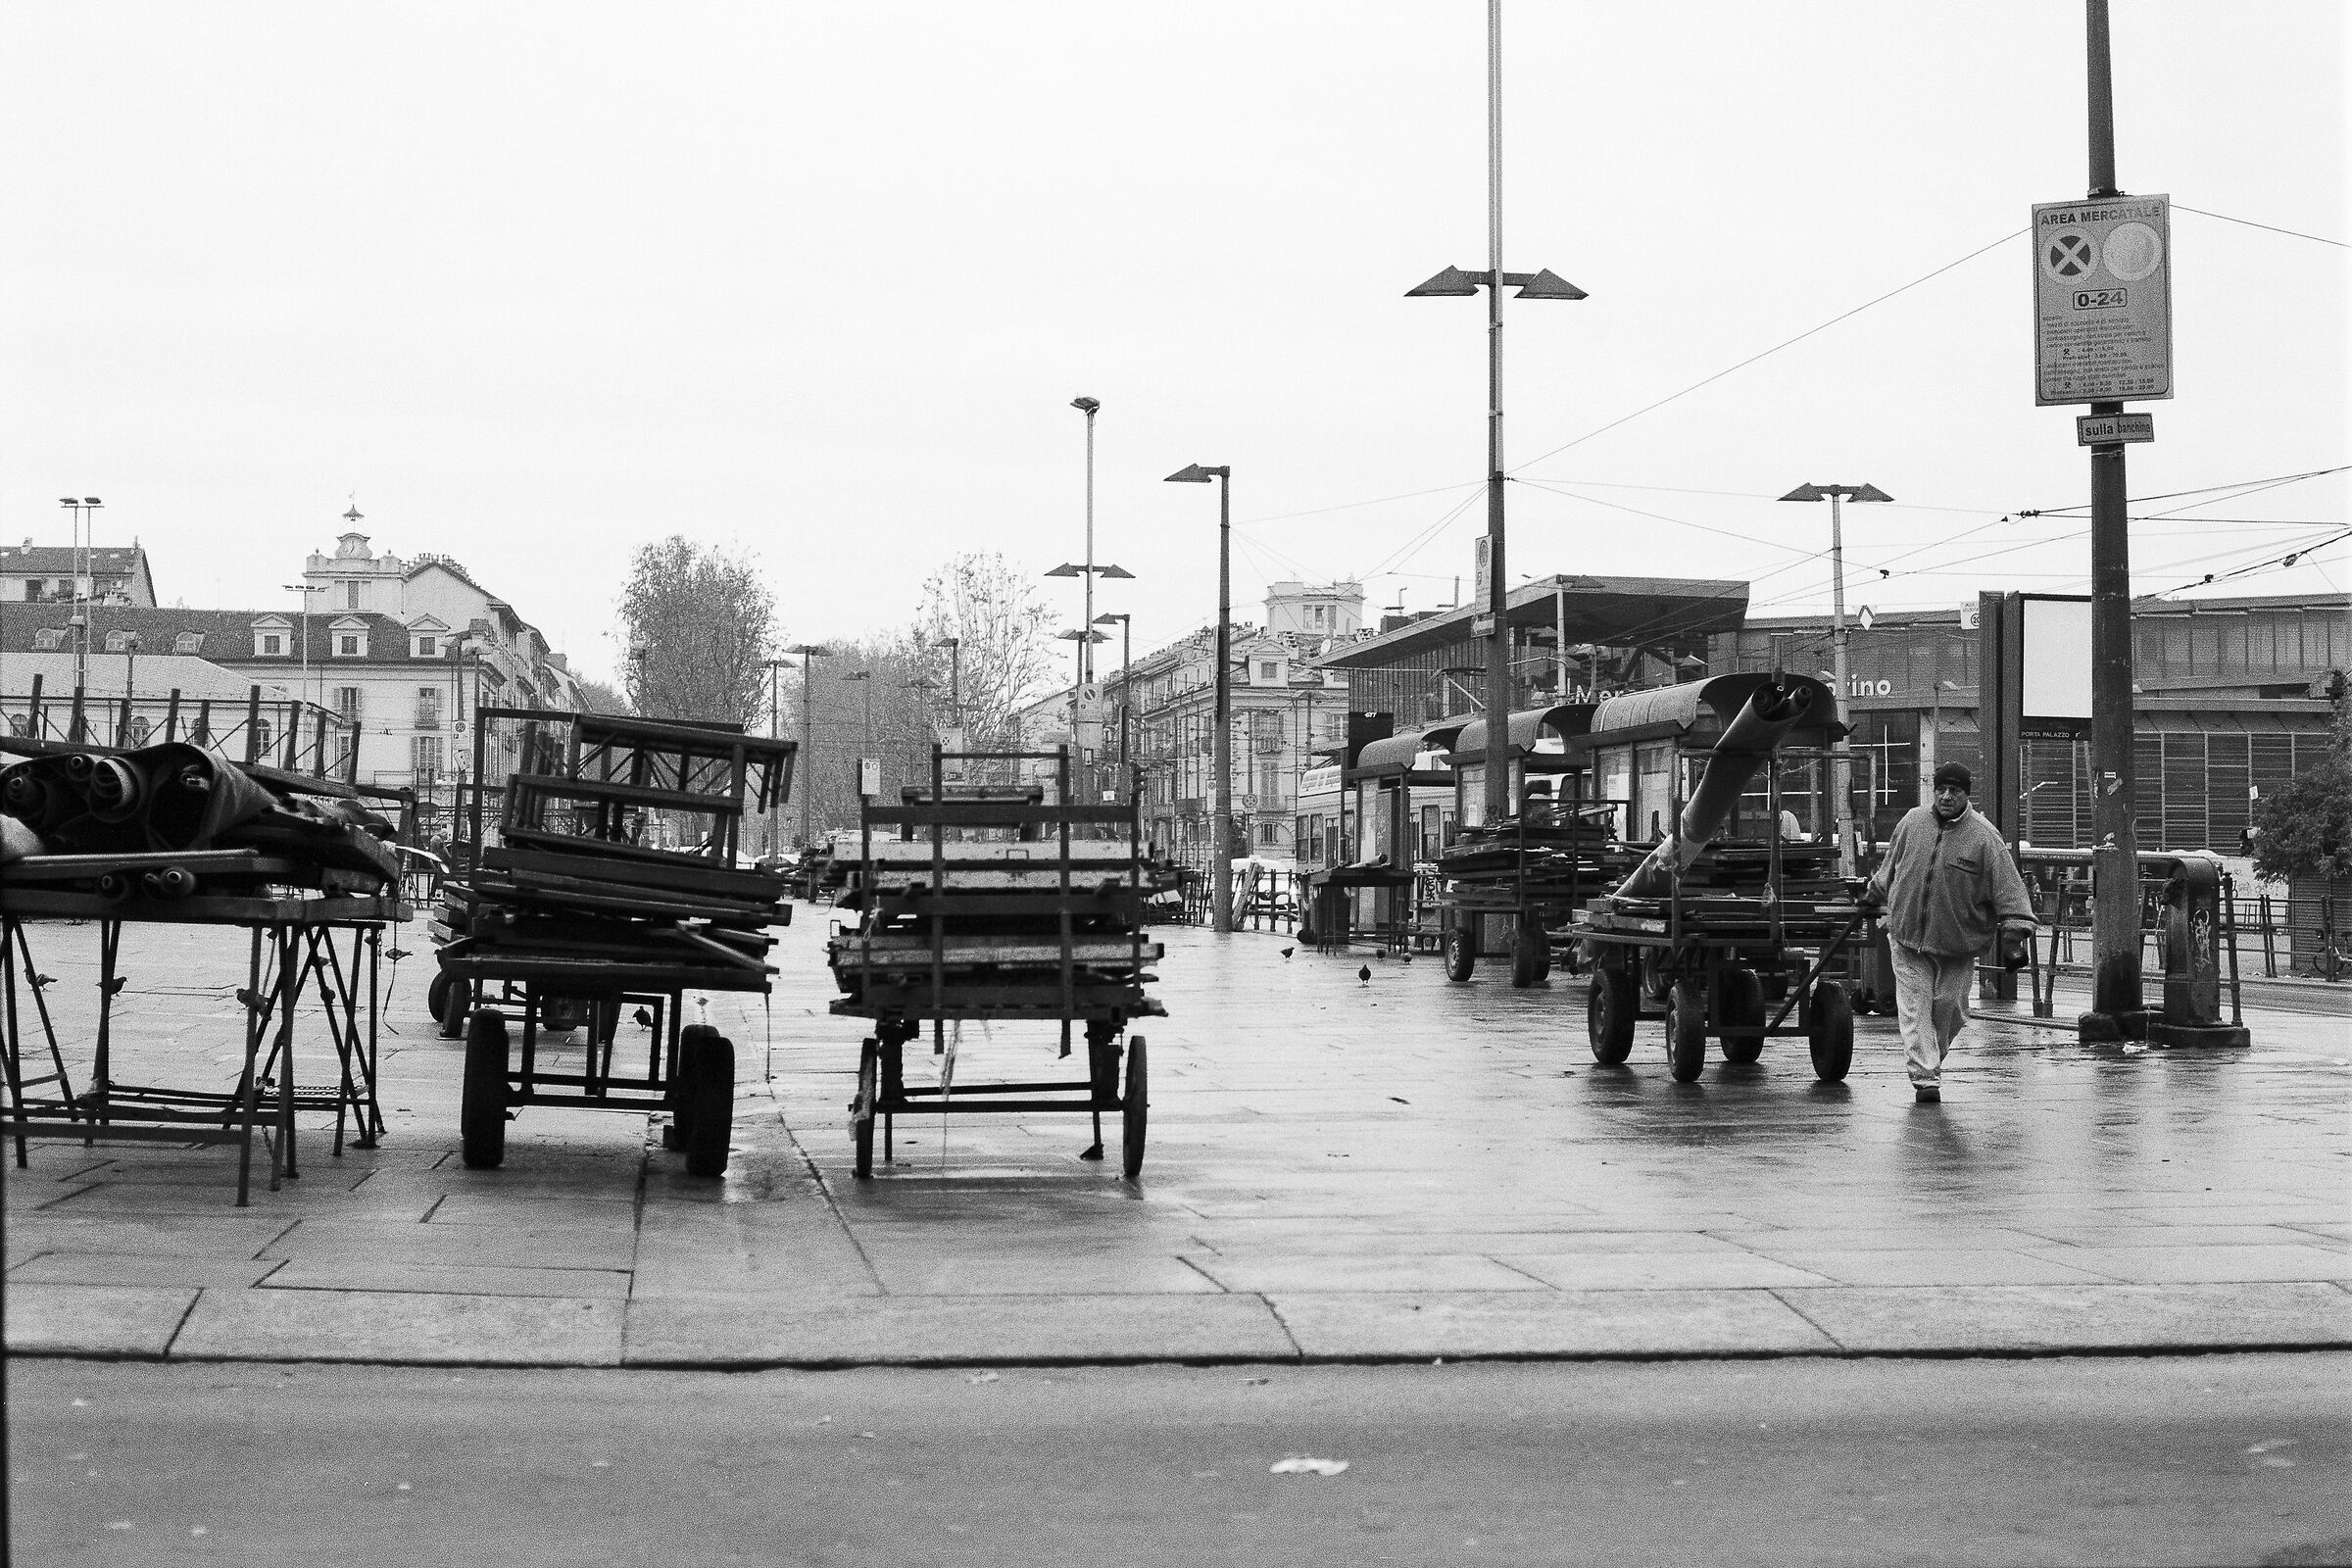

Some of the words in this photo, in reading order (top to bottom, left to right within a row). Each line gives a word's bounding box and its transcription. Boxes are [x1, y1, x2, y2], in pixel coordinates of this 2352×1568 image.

[2040, 213, 2077, 225] AREA
[2081, 207, 2160, 222] MERCATALE
[2078, 291, 2124, 307] 0-24
[2085, 423, 2114, 436] sulla
[2117, 420, 2150, 433] banchina
